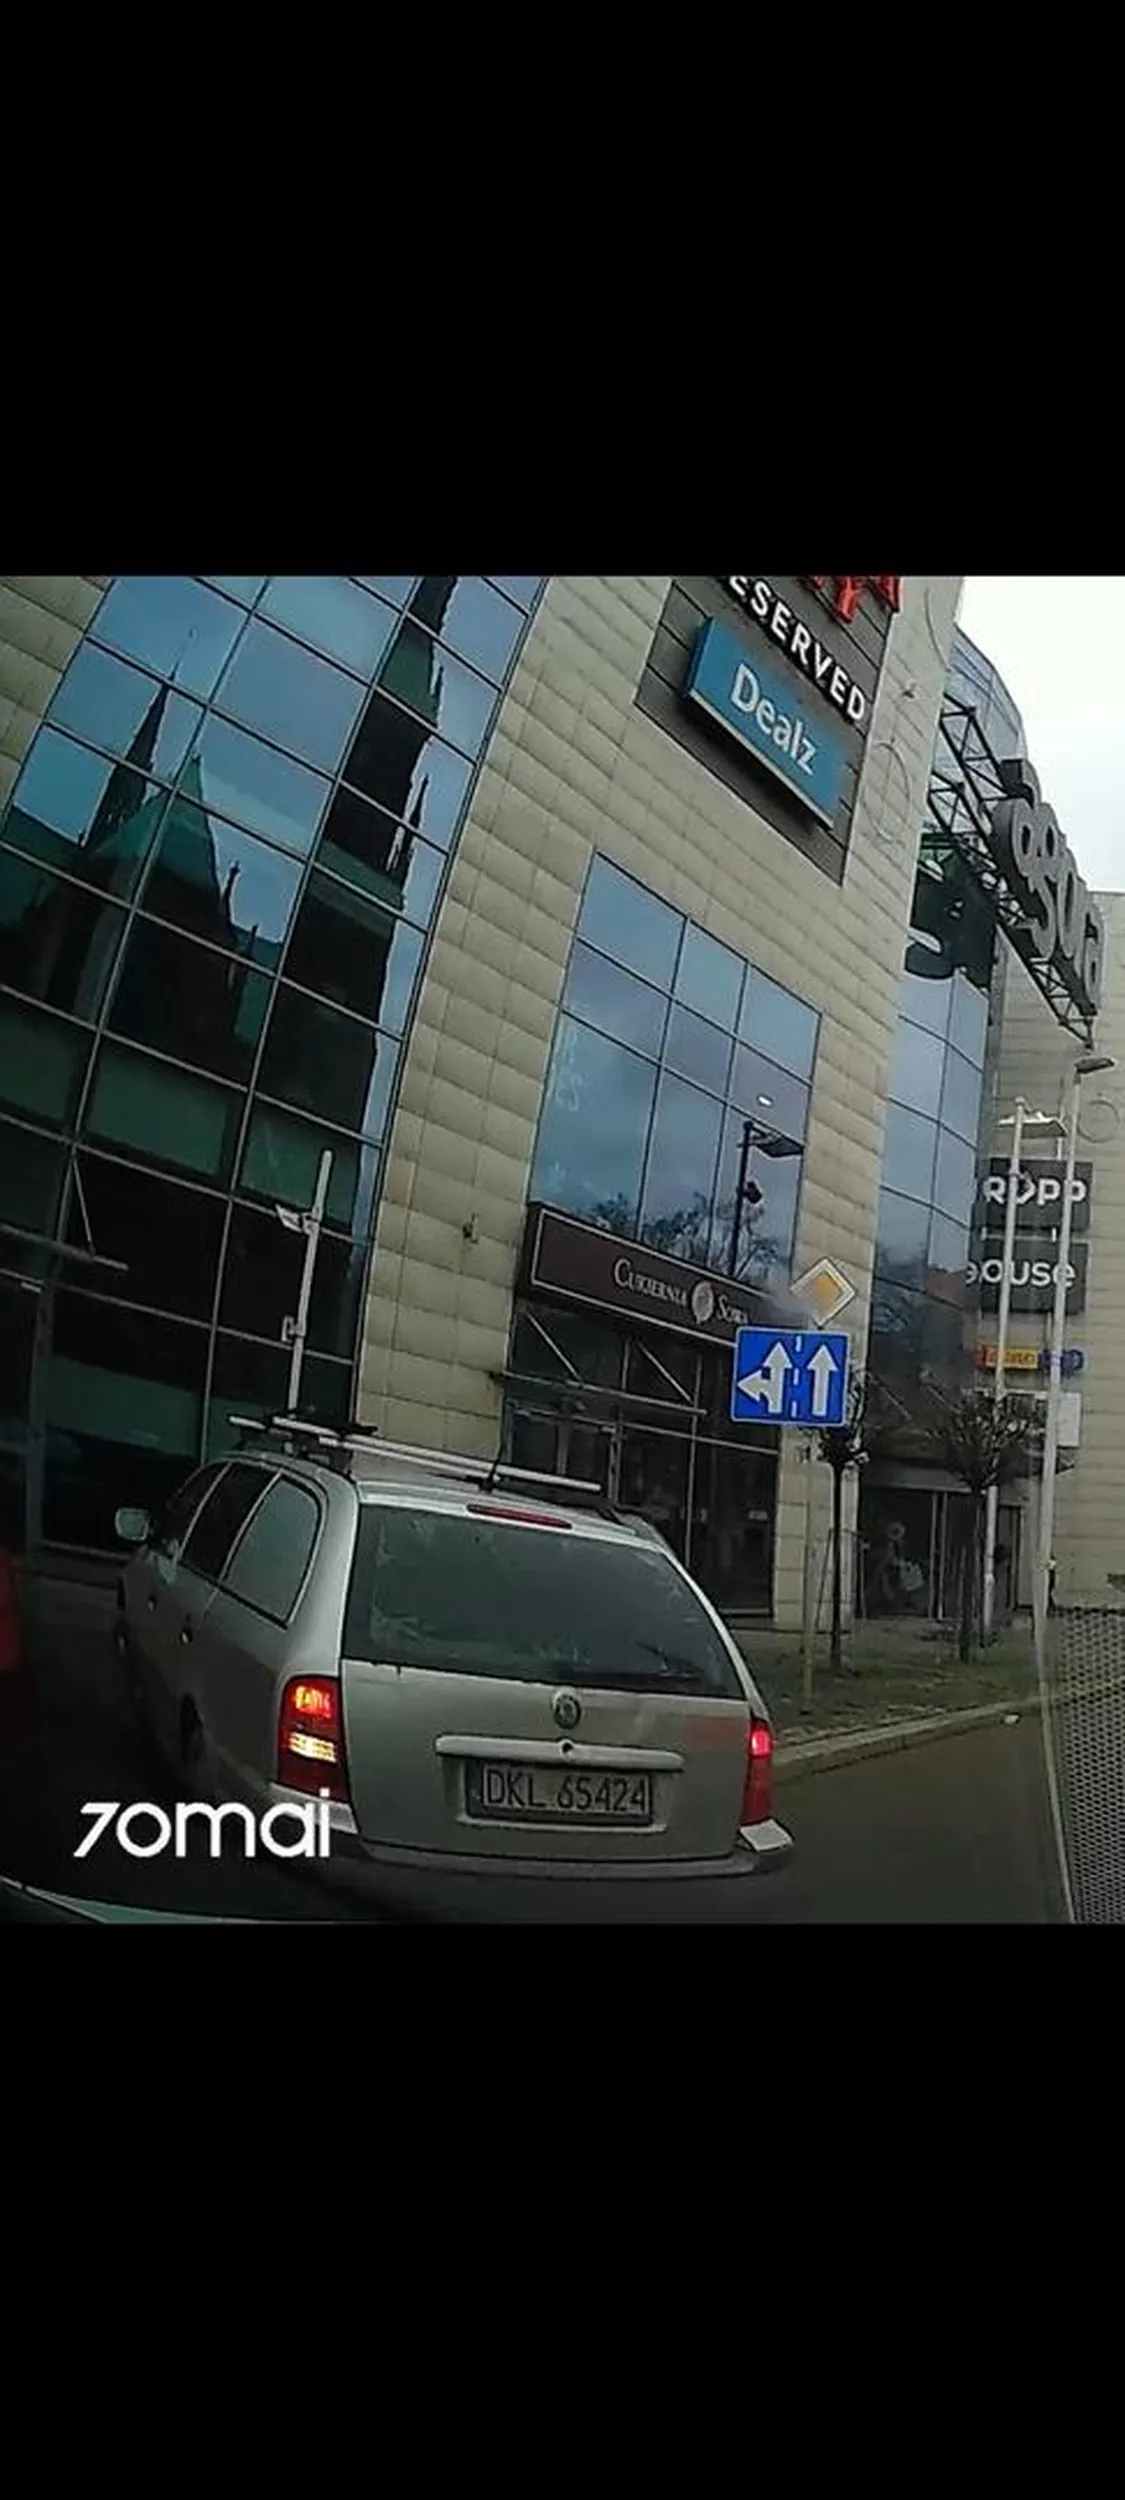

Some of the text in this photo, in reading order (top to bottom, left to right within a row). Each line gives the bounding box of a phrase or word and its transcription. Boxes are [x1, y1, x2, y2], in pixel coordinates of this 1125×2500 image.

[730, 663, 816, 776] Dealz
[486, 1768, 648, 1813] DKL 65424
